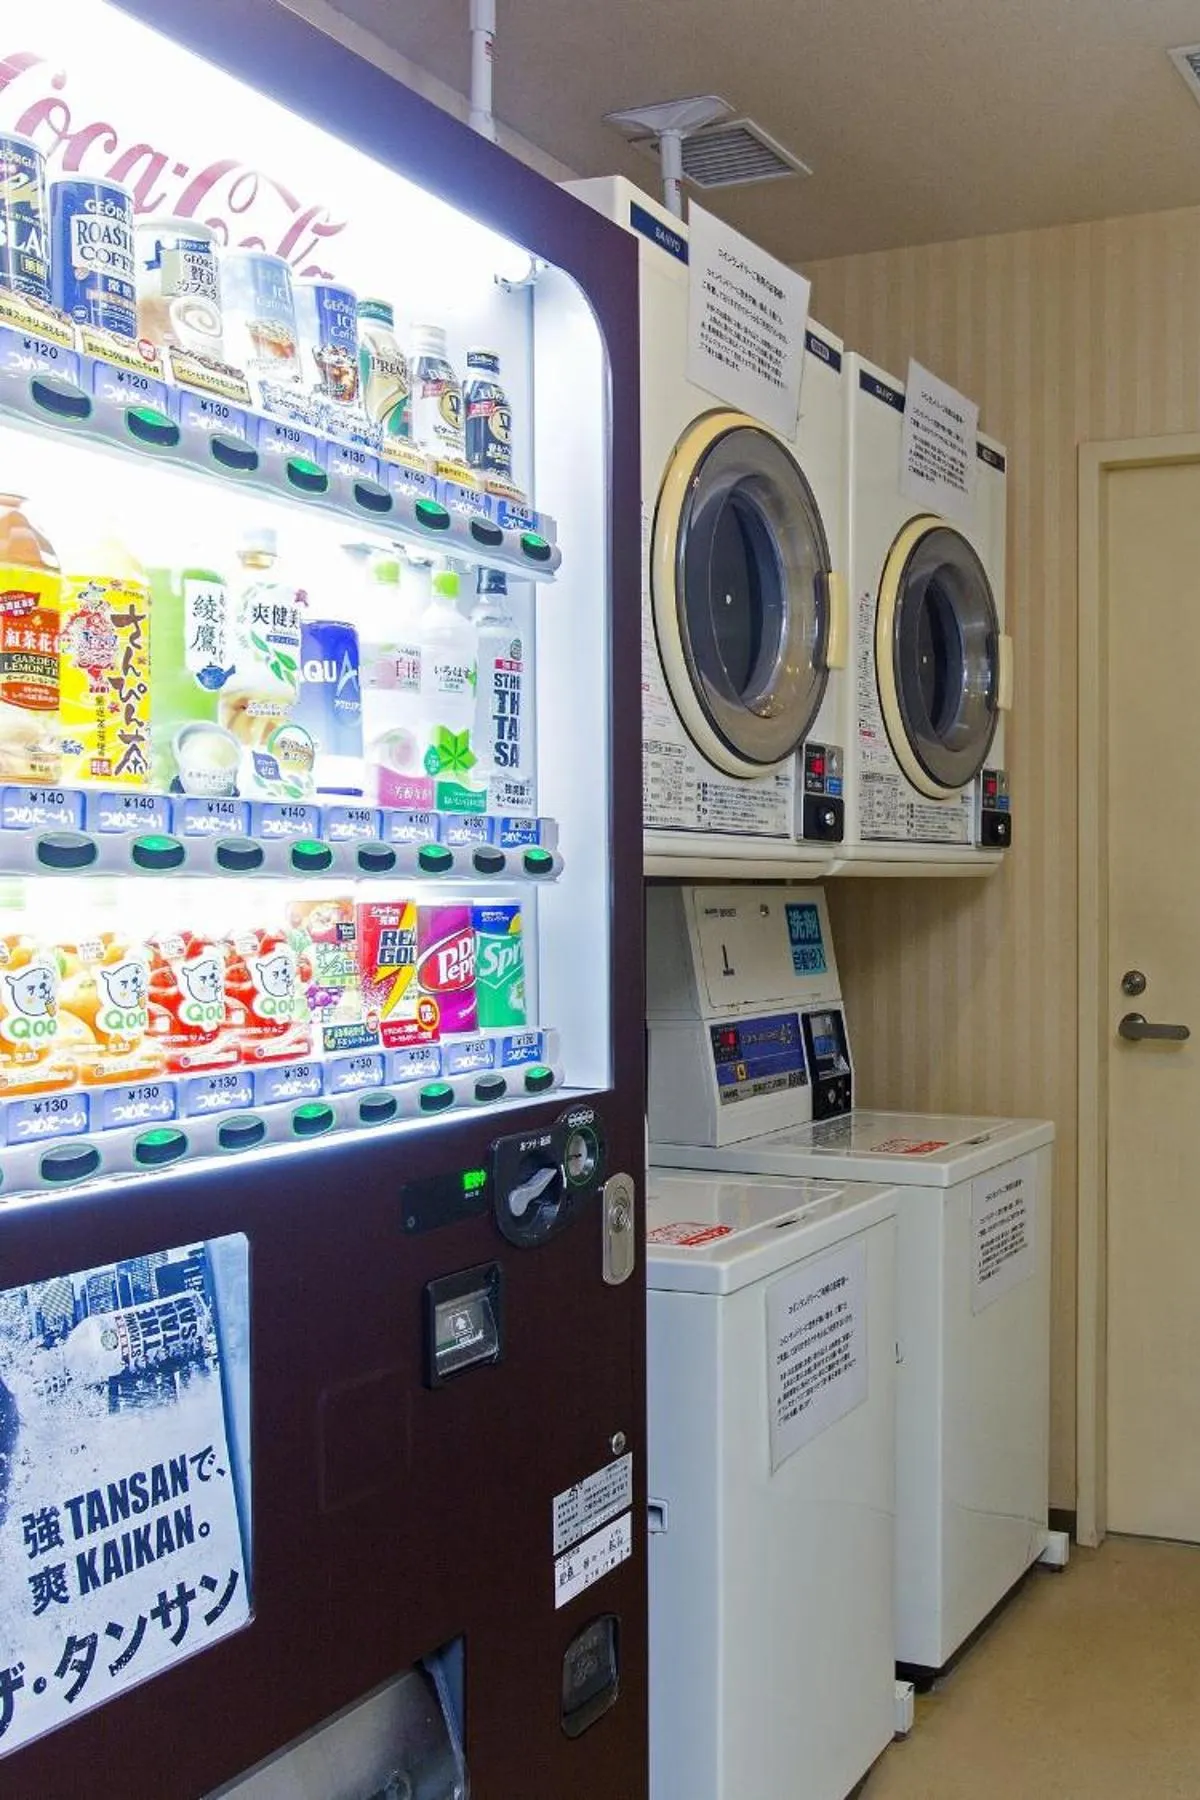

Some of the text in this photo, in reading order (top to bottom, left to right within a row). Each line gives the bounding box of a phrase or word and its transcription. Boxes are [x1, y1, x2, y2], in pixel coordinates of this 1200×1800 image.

[655, 226, 682, 253] SANYO
[24, 337, 59, 359] ¥120
[117, 370, 149, 391] ¥120
[200, 399, 230, 419] ¥130
[275, 425, 301, 444] ¥130
[191, 593, 219, 656] 綾鷹
[4, 661, 44, 674] LEMON
[108, 604, 148, 776] さんぴん茶
[29, 791, 65, 804] ¥140
[124, 796, 155, 809] ¥140
[207, 802, 235, 814] ¥140
[280, 806, 306, 818] ¥140
[347, 810, 371, 822] ¥140
[185, 1002, 223, 1024] Qoo
[259, 996, 296, 1018] Qoo
[9, 1016, 58, 1039] Qoo
[104, 1008, 148, 1031] Qoo
[284, 1067, 310, 1079] ¥130
[209, 1076, 238, 1090] ¥130
[127, 1087, 160, 1101] ¥130
[34, 1099, 69, 1114] ¥130
[136, 1307, 162, 1354] THE
